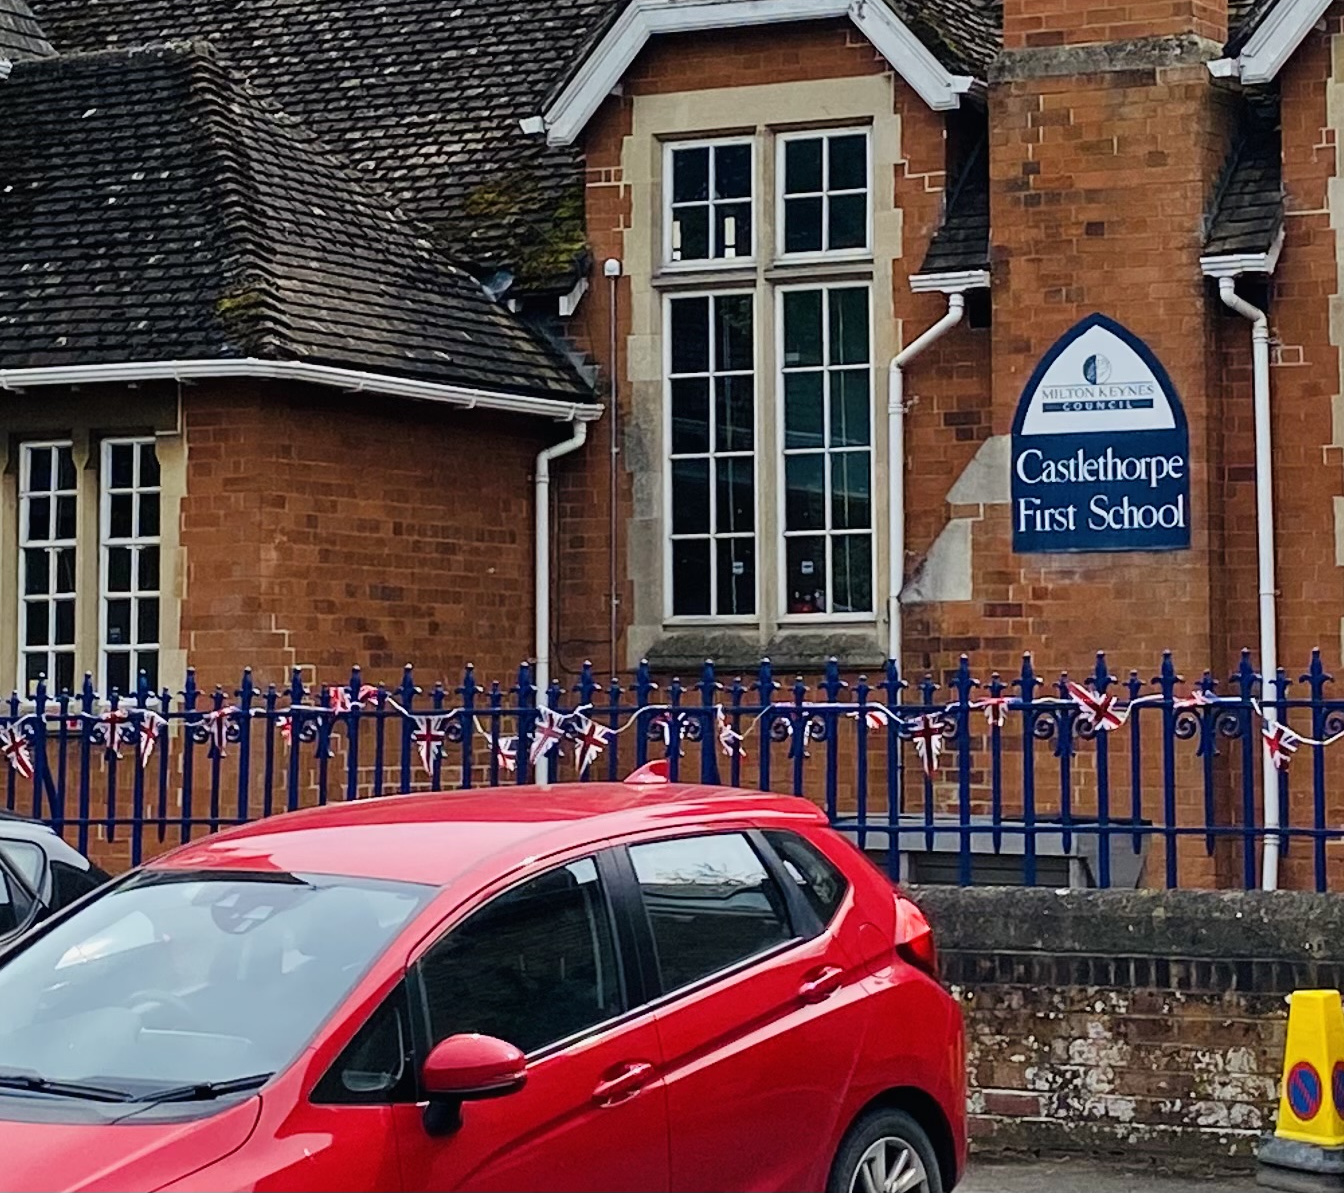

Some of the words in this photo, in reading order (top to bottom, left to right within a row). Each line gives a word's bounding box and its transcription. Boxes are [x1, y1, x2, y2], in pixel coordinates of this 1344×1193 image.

[1042, 387, 1095, 400] MILTON
[1098, 384, 1155, 398] KEYNES
[1062, 400, 1133, 412] COUNCIL
[1016, 447, 1184, 488] Castlethorpe
[1017, 497, 1077, 533] First
[1088, 493, 1185, 530] School
